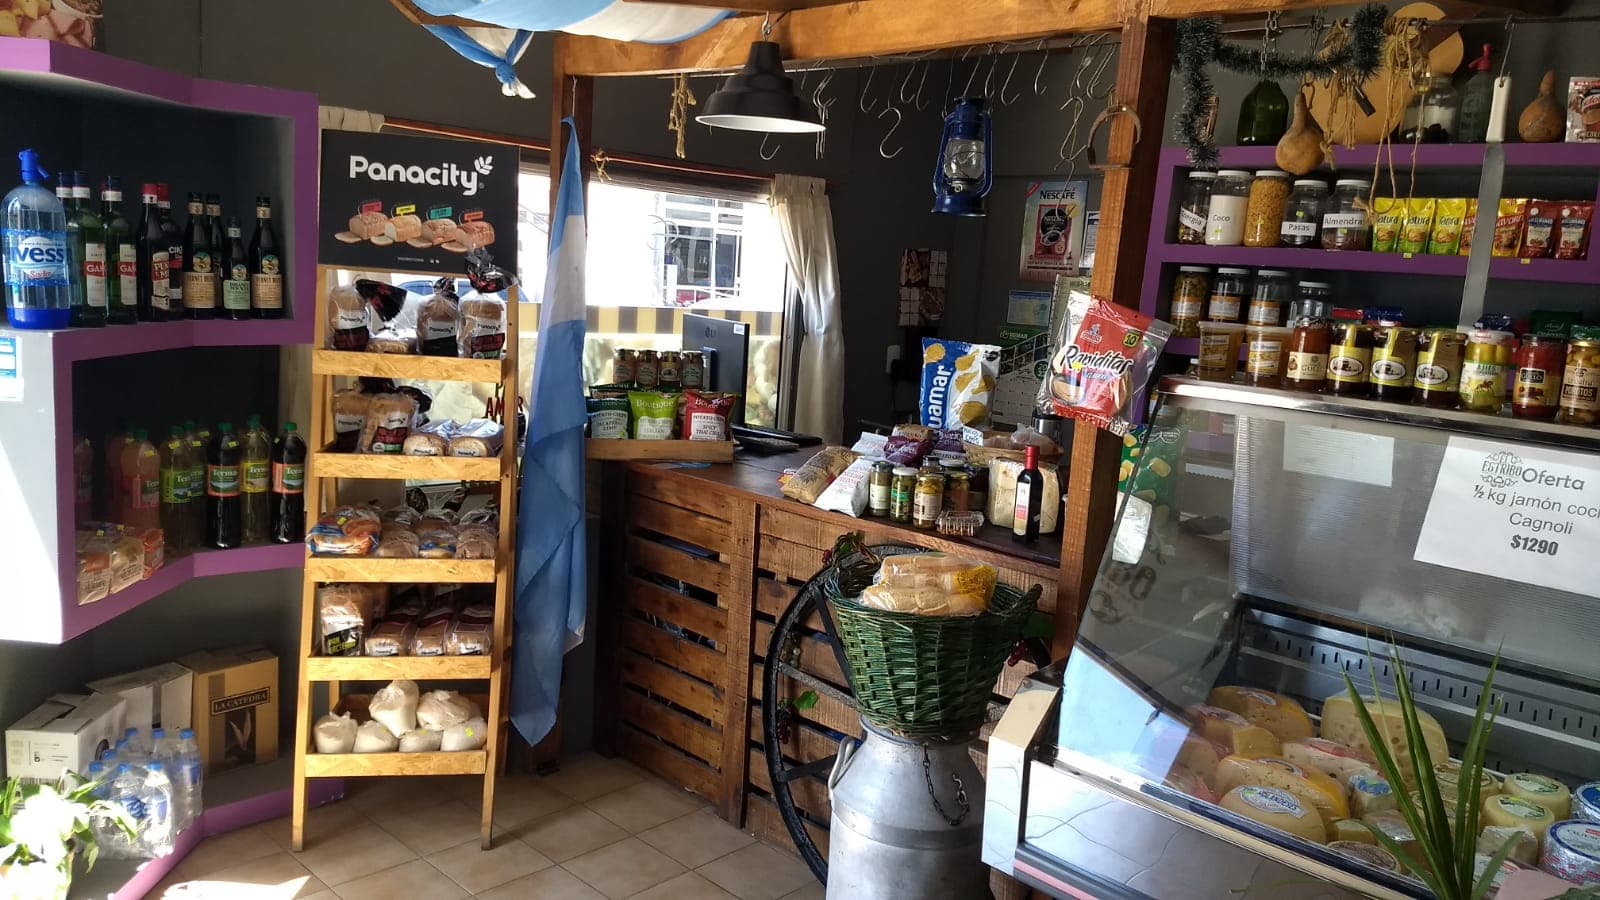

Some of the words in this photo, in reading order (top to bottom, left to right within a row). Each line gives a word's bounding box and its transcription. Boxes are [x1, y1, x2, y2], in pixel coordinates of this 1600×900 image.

[350, 155, 478, 196] Panacity
[1212, 214, 1231, 222] Coco
[1288, 223, 1311, 232] Pasas
[1124, 334, 1137, 347] 10
[1059, 345, 1133, 376] Rapiditas
[1482, 459, 1523, 477] ESTRIBO
[1521, 468, 1585, 491] Oferta
[1487, 488, 1506, 505] kg
[1509, 491, 1562, 512] jamón
[1509, 513, 1574, 535] Cagnoli
[1510, 534, 1559, 556] $1290
